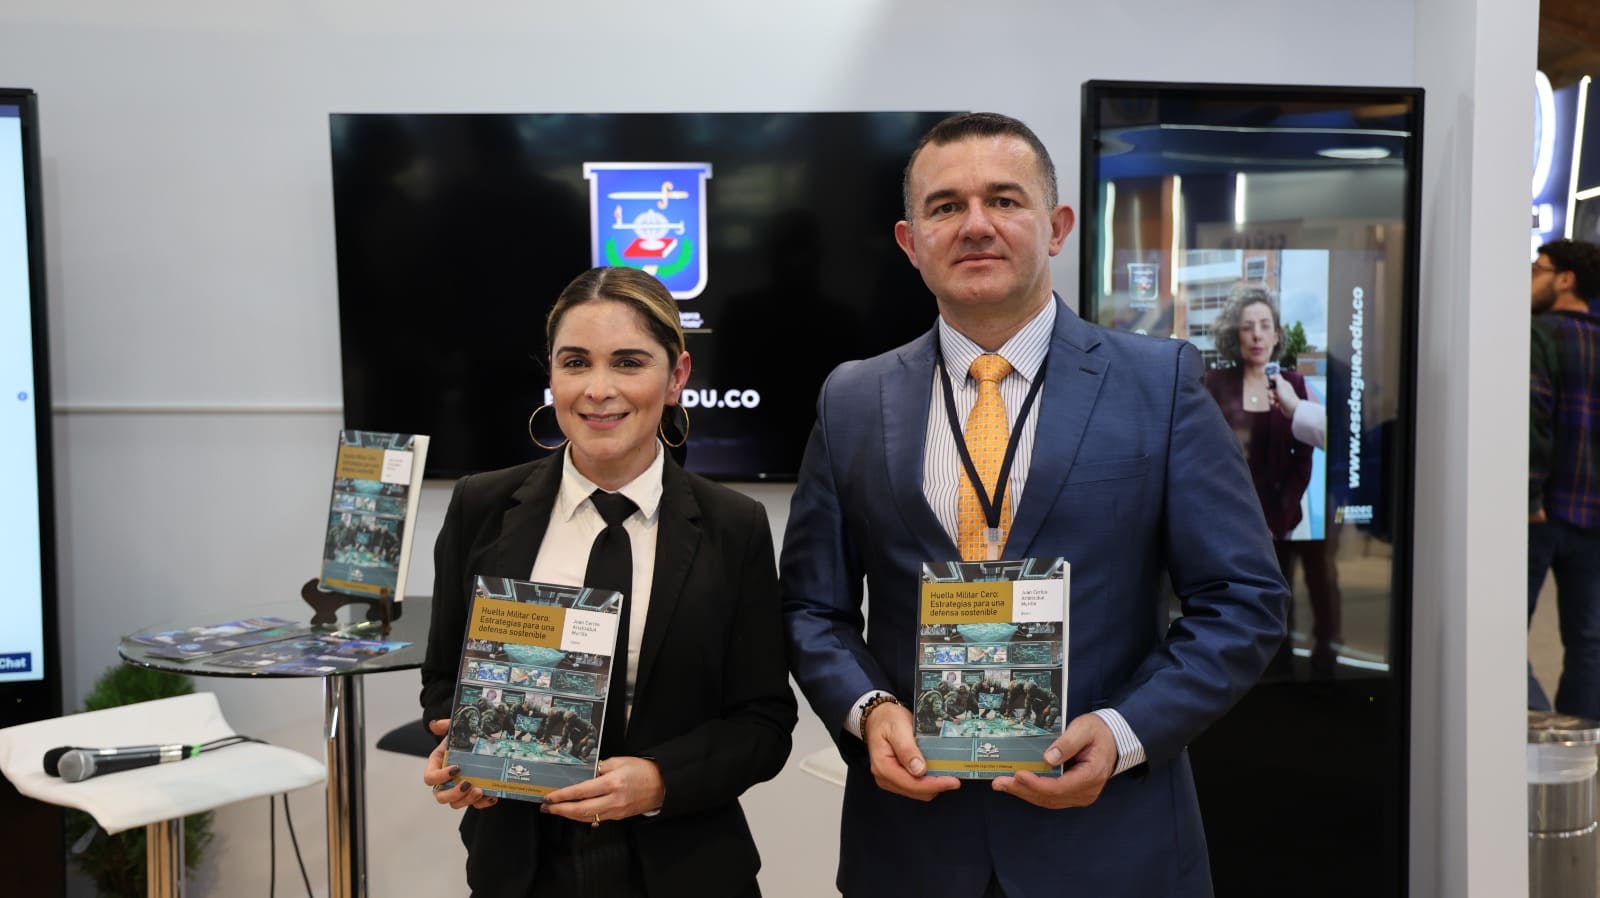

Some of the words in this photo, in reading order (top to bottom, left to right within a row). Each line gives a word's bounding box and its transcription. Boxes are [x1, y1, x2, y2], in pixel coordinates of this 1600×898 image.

[1348, 286, 1364, 489] www.esdegue.edu.co
[930, 591, 954, 599] Huella
[956, 590, 978, 599] Militar
[980, 590, 999, 598] Cero:
[930, 600, 972, 609] Estrategias
[973, 601, 990, 609] para
[481, 607, 505, 617] Huella
[506, 609, 530, 620] Militar
[531, 612, 551, 622] Cero:
[929, 609, 959, 617] defensa
[960, 608, 998, 617] sostenible
[480, 615, 522, 628] Estrategias
[522, 621, 540, 632] para
[541, 623, 555, 633] una
[478, 624, 508, 635] defensa
[509, 627, 547, 640] sostenible
